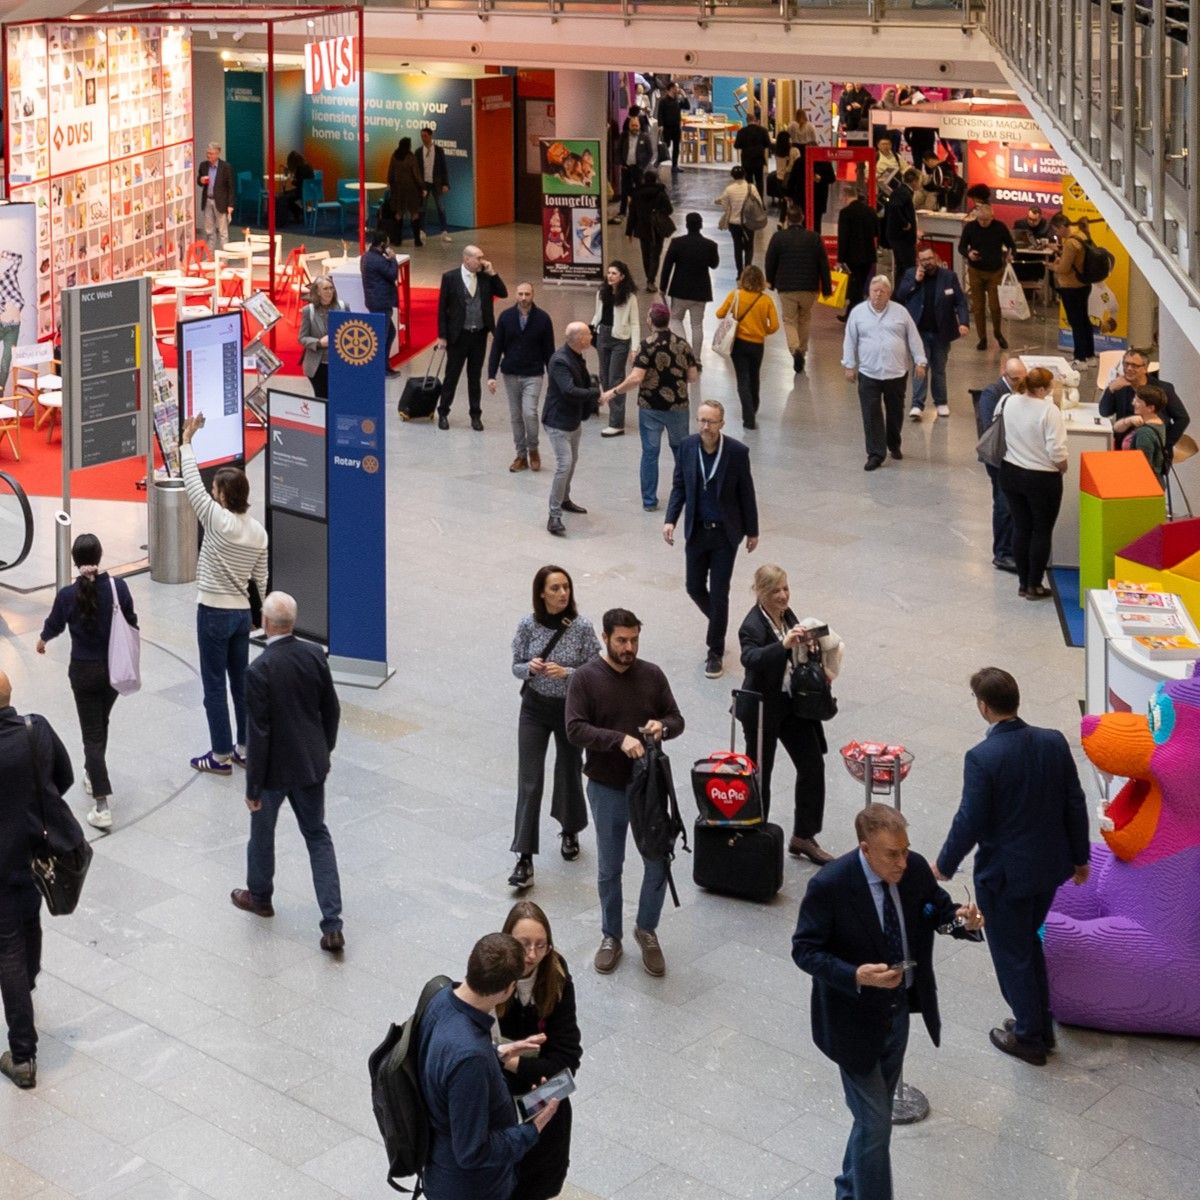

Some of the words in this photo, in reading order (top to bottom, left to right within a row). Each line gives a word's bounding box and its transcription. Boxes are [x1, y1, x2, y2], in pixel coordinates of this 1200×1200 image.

[307, 35, 358, 96] DVSI
[385, 99, 403, 110] are
[405, 101, 420, 111] on
[422, 102, 449, 117] your
[312, 109, 358, 127] licensing
[406, 119, 437, 131] come
[942, 116, 993, 129] LICENSING
[995, 119, 1042, 131] MAGAZIN
[67, 121, 93, 146] DVSI
[312, 126, 341, 140] home
[343, 128, 355, 141] to
[966, 130, 980, 139] (by
[982, 131, 998, 140] BM
[1000, 131, 1022, 141] SRL)
[545, 194, 598, 208] loungefly
[995, 189, 1035, 202] SOCIAL
[1035, 191, 1051, 204] TV
[81, 292, 96, 302] NCC
[96, 290, 113, 300] West
[333, 455, 362, 469] Rotary
